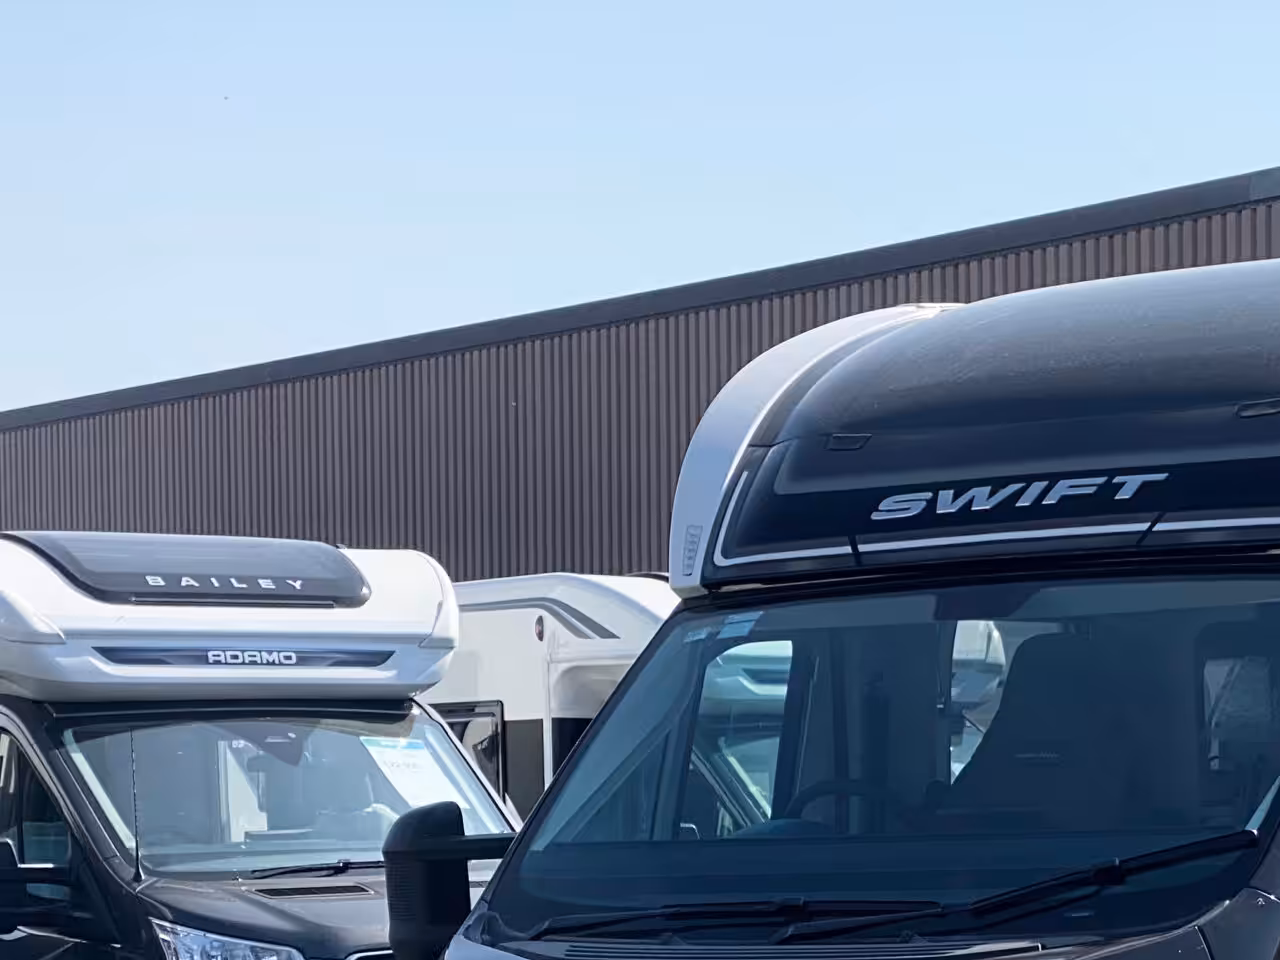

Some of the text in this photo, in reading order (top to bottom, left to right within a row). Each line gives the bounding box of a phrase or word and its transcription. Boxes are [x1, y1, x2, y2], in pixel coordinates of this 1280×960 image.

[870, 473, 1169, 520] SWIFT
[145, 575, 303, 590] BAILEY
[207, 650, 297, 664] ADAMO
